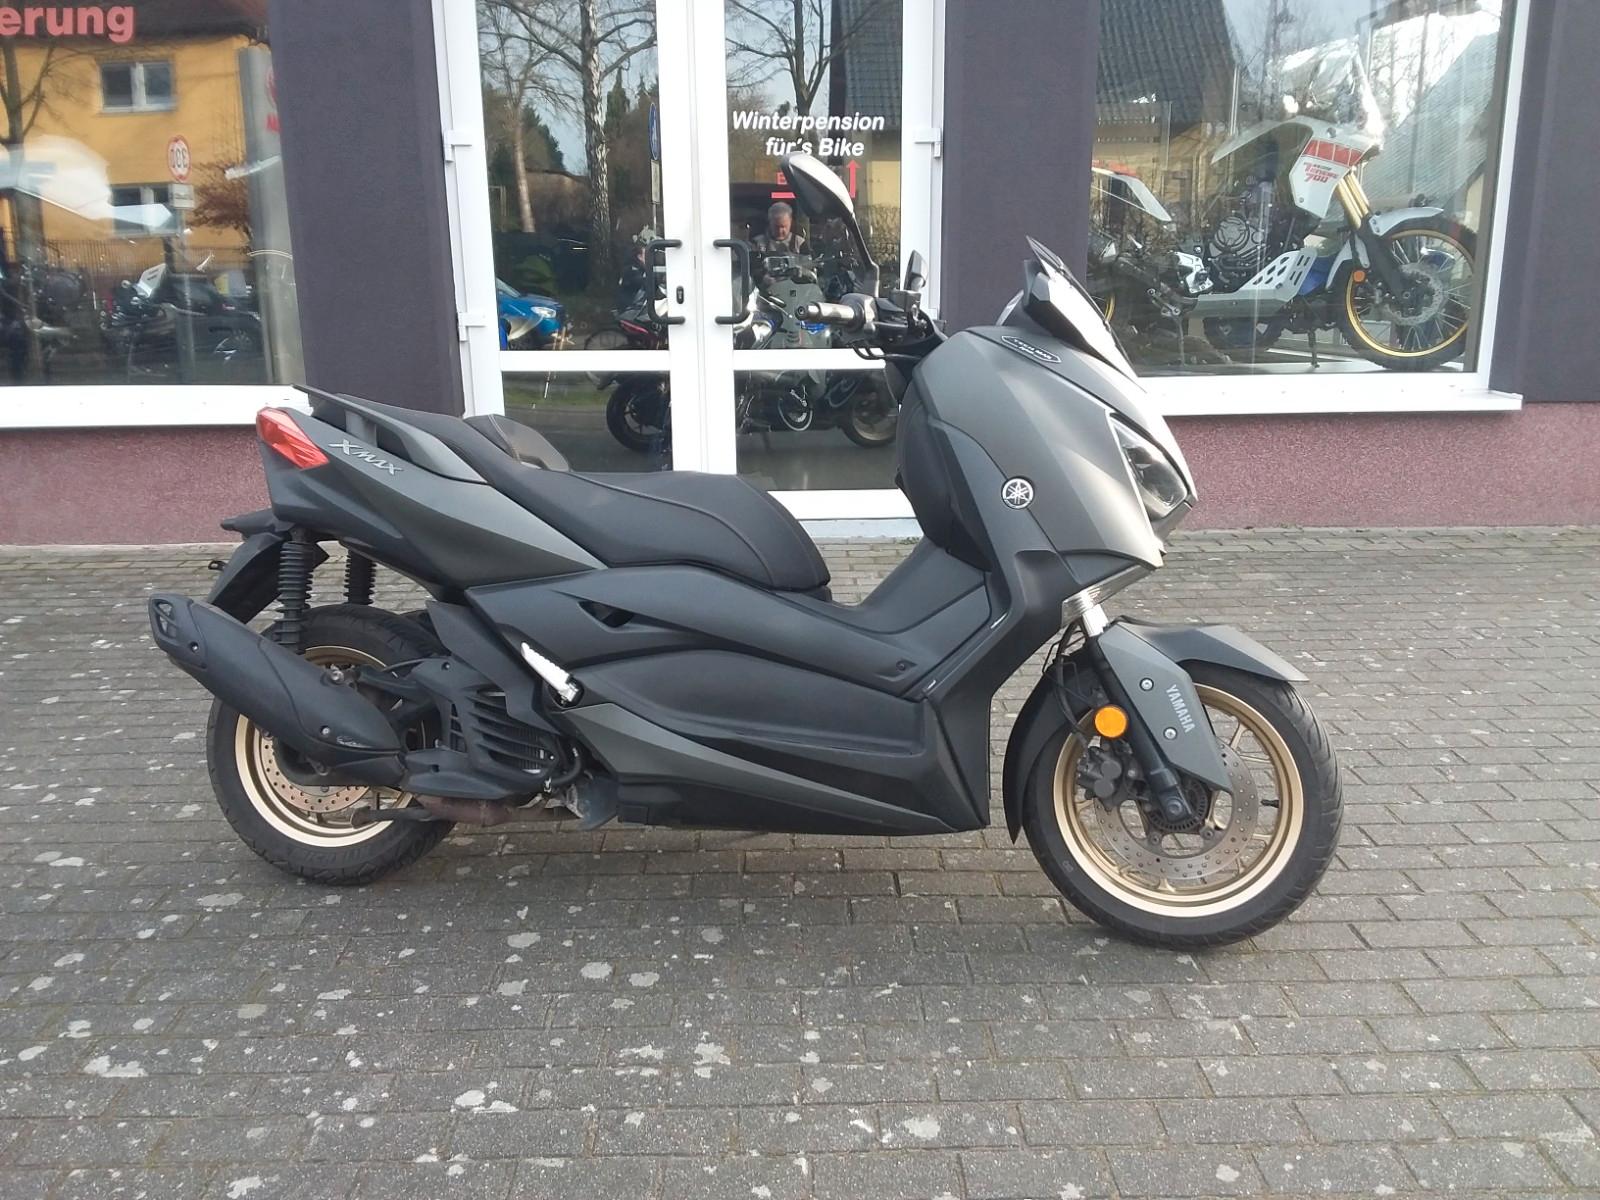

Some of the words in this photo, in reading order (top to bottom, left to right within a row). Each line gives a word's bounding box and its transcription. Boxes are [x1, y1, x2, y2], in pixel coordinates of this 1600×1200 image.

[0, 6, 134, 43] erung
[732, 110, 885, 134] Winterpension
[818, 137, 865, 157] Bike
[1166, 684, 1195, 733] YAMAHA
